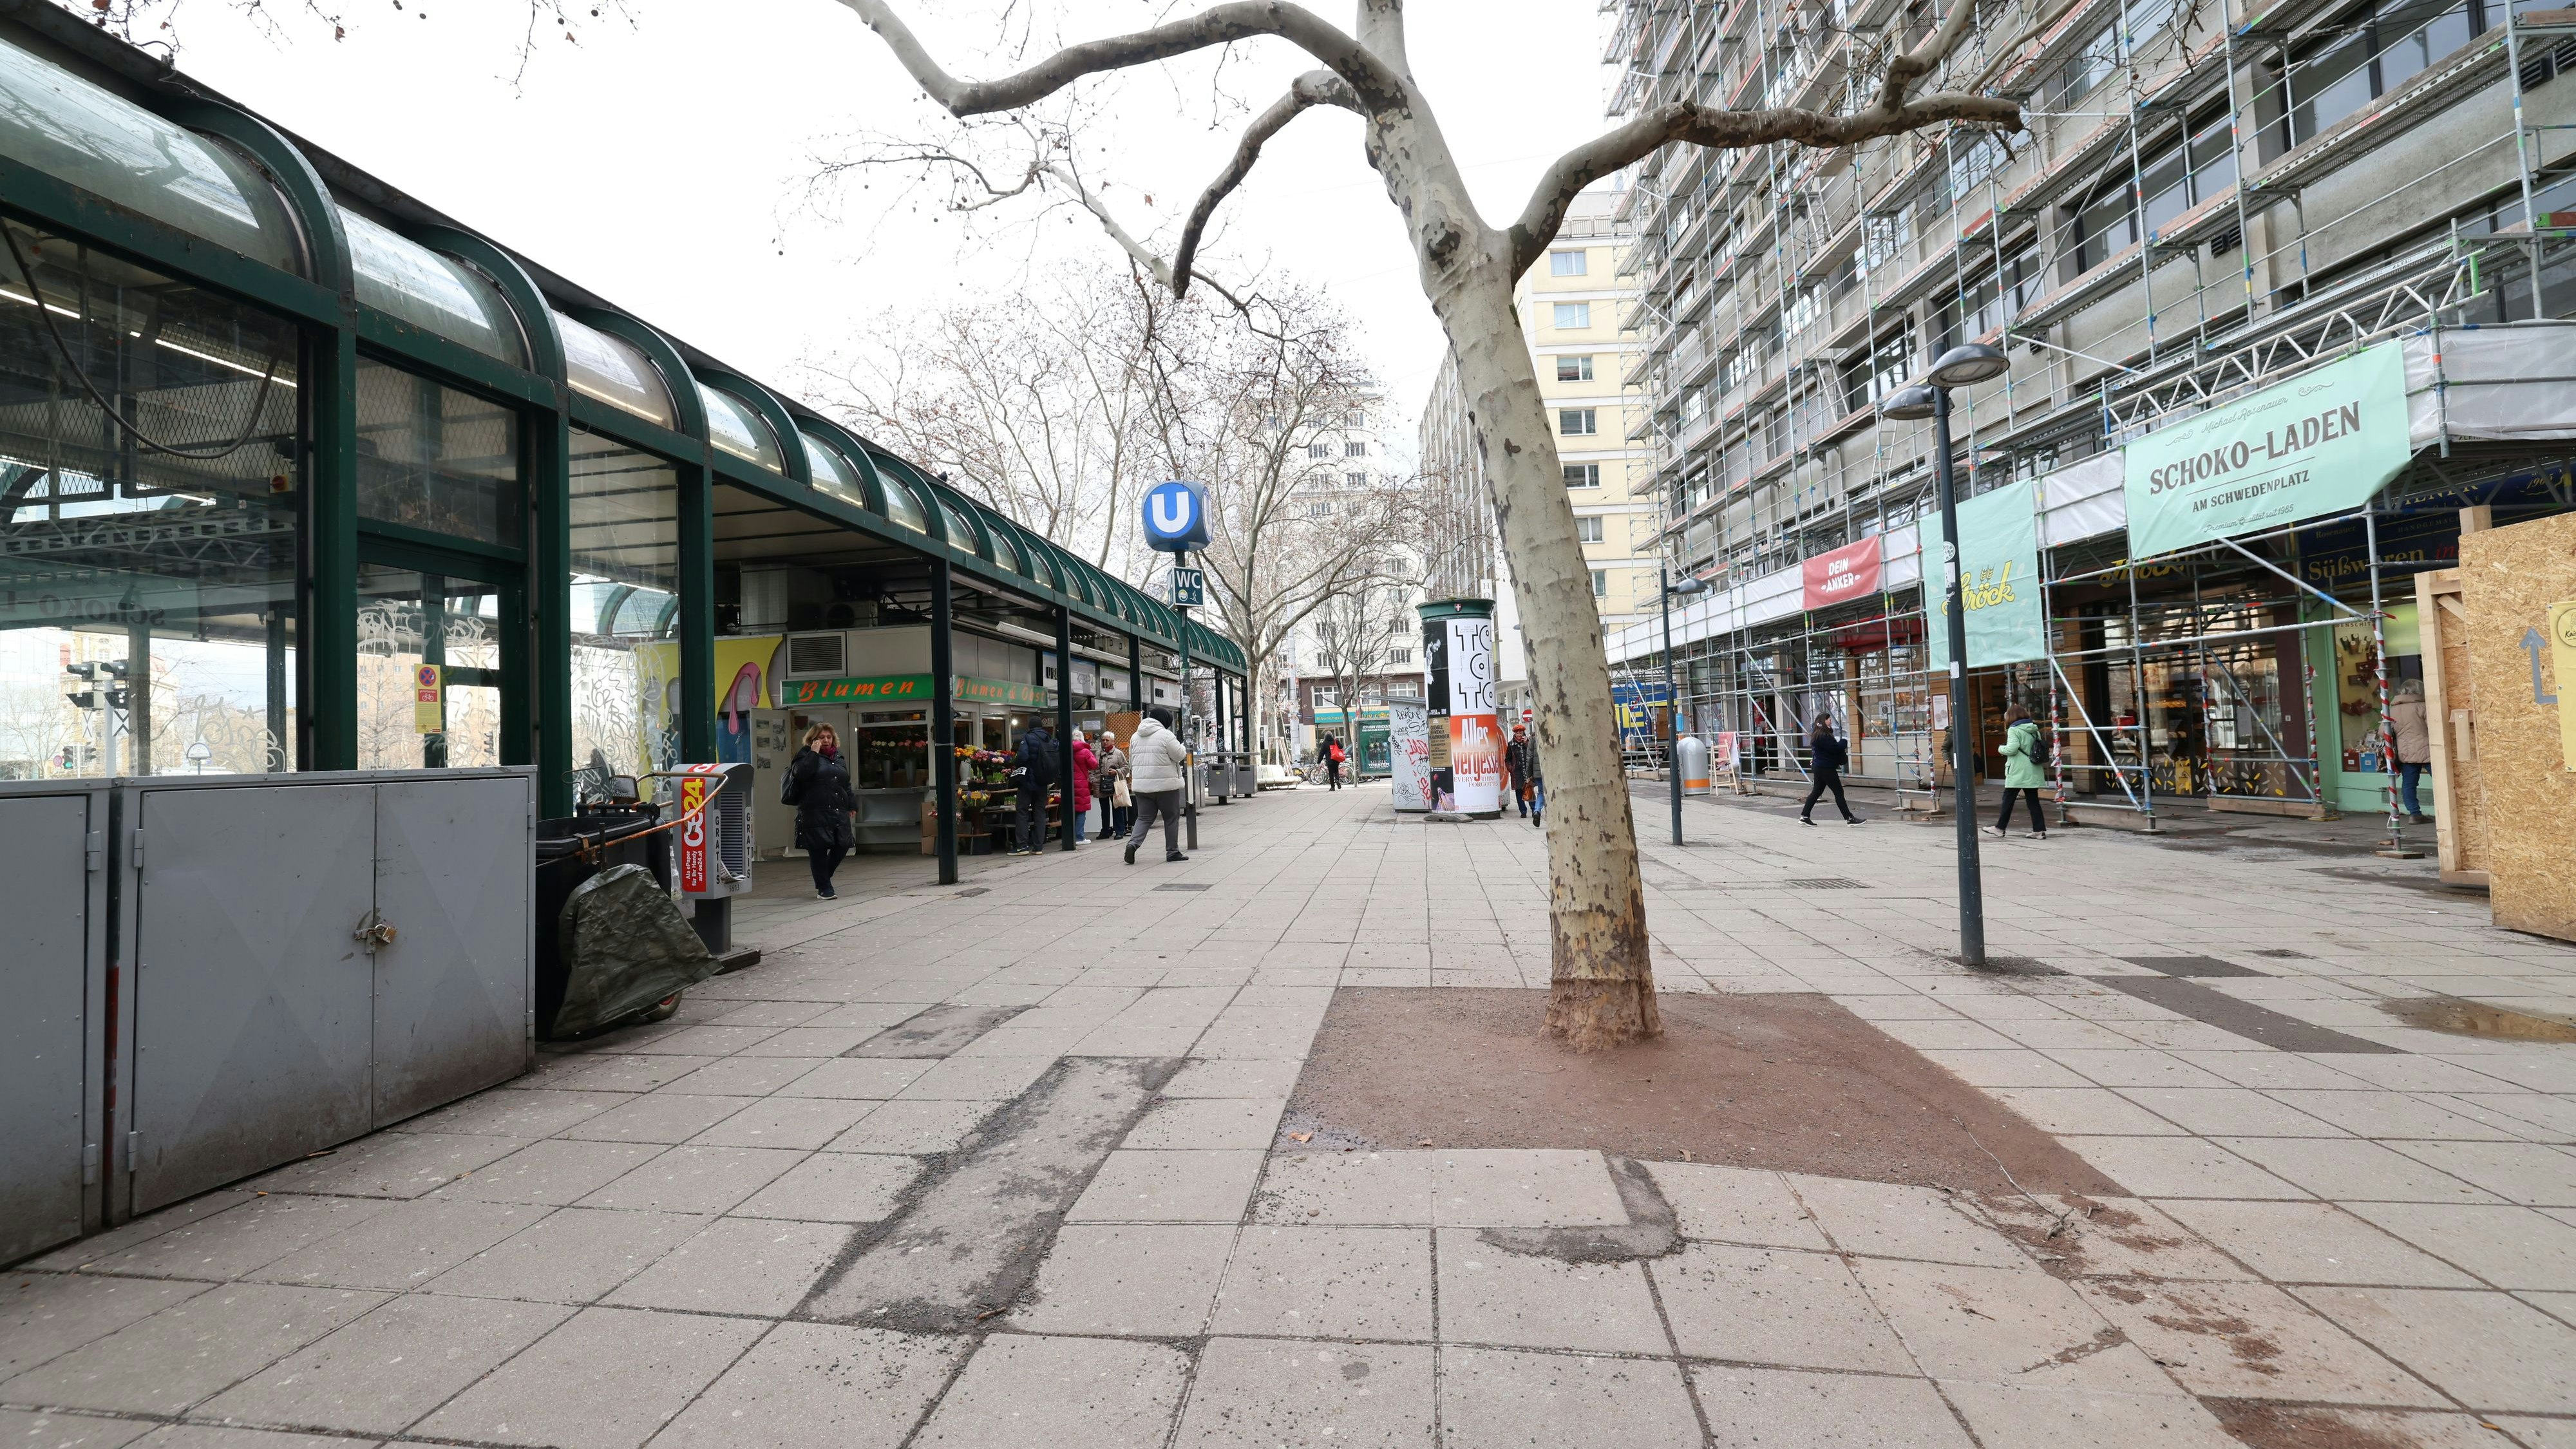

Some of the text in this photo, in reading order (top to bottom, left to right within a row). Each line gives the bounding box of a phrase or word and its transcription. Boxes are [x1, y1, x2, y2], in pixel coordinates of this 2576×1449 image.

[2201, 397, 2289, 433] Michael Rosenauer
[2150, 400, 2360, 496] SCHOKO-LADEN
[2193, 469, 2310, 513] AM SCHWEDENPLATZ
[1151, 491, 1189, 533] U
[2204, 504, 2294, 533] Premium Qlität seit 1985
[1828, 557, 1849, 576] DEIN
[2308, 549, 2425, 580] Süßwren
[1176, 571, 1201, 589] WC
[1826, 573, 1854, 593] ANKER
[798, 680, 915, 703] Blumen
[954, 678, 1045, 703] Blumen & Obst
[1462, 718, 1489, 747] Alles
